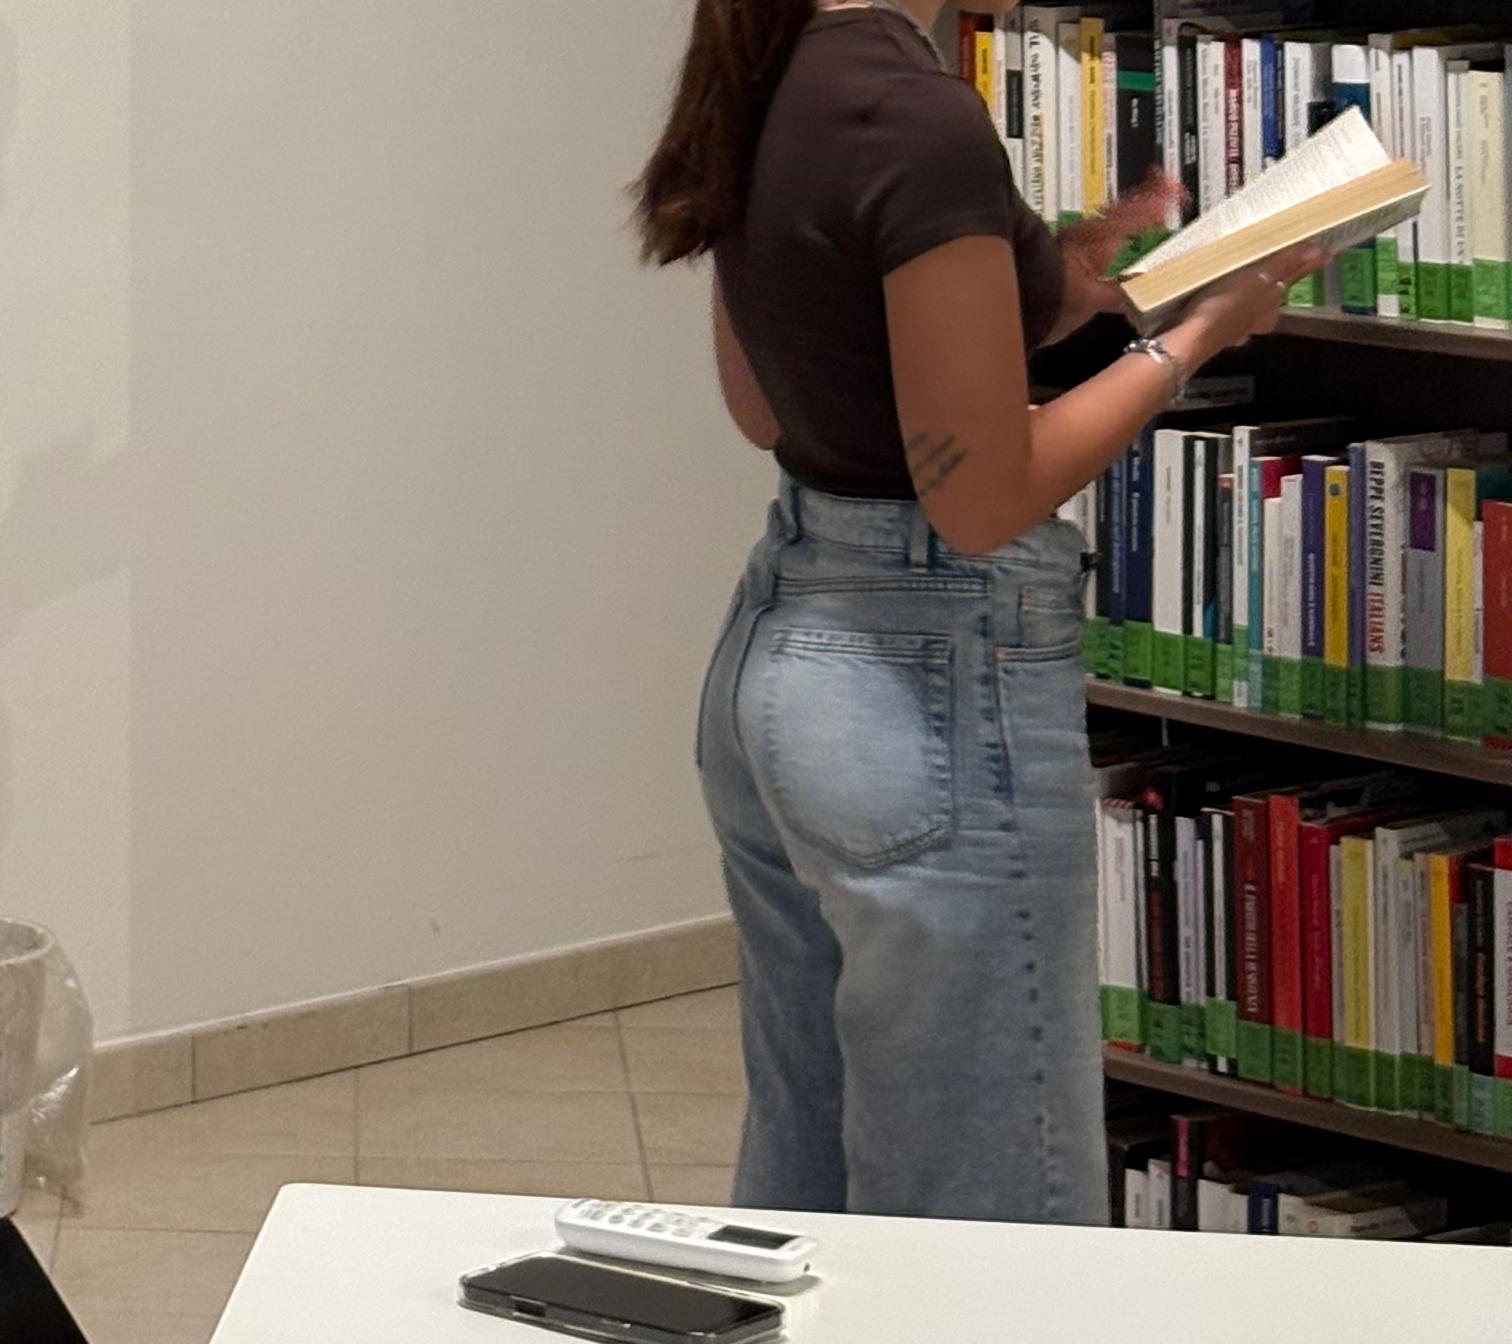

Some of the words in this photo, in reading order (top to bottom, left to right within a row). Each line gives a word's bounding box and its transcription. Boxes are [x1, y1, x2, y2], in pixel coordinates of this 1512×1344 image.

[1369, 460, 1386, 504] BEPPE
[1368, 505, 1385, 586] SEVERGNINI
[1368, 591, 1385, 654] ITALIANS
